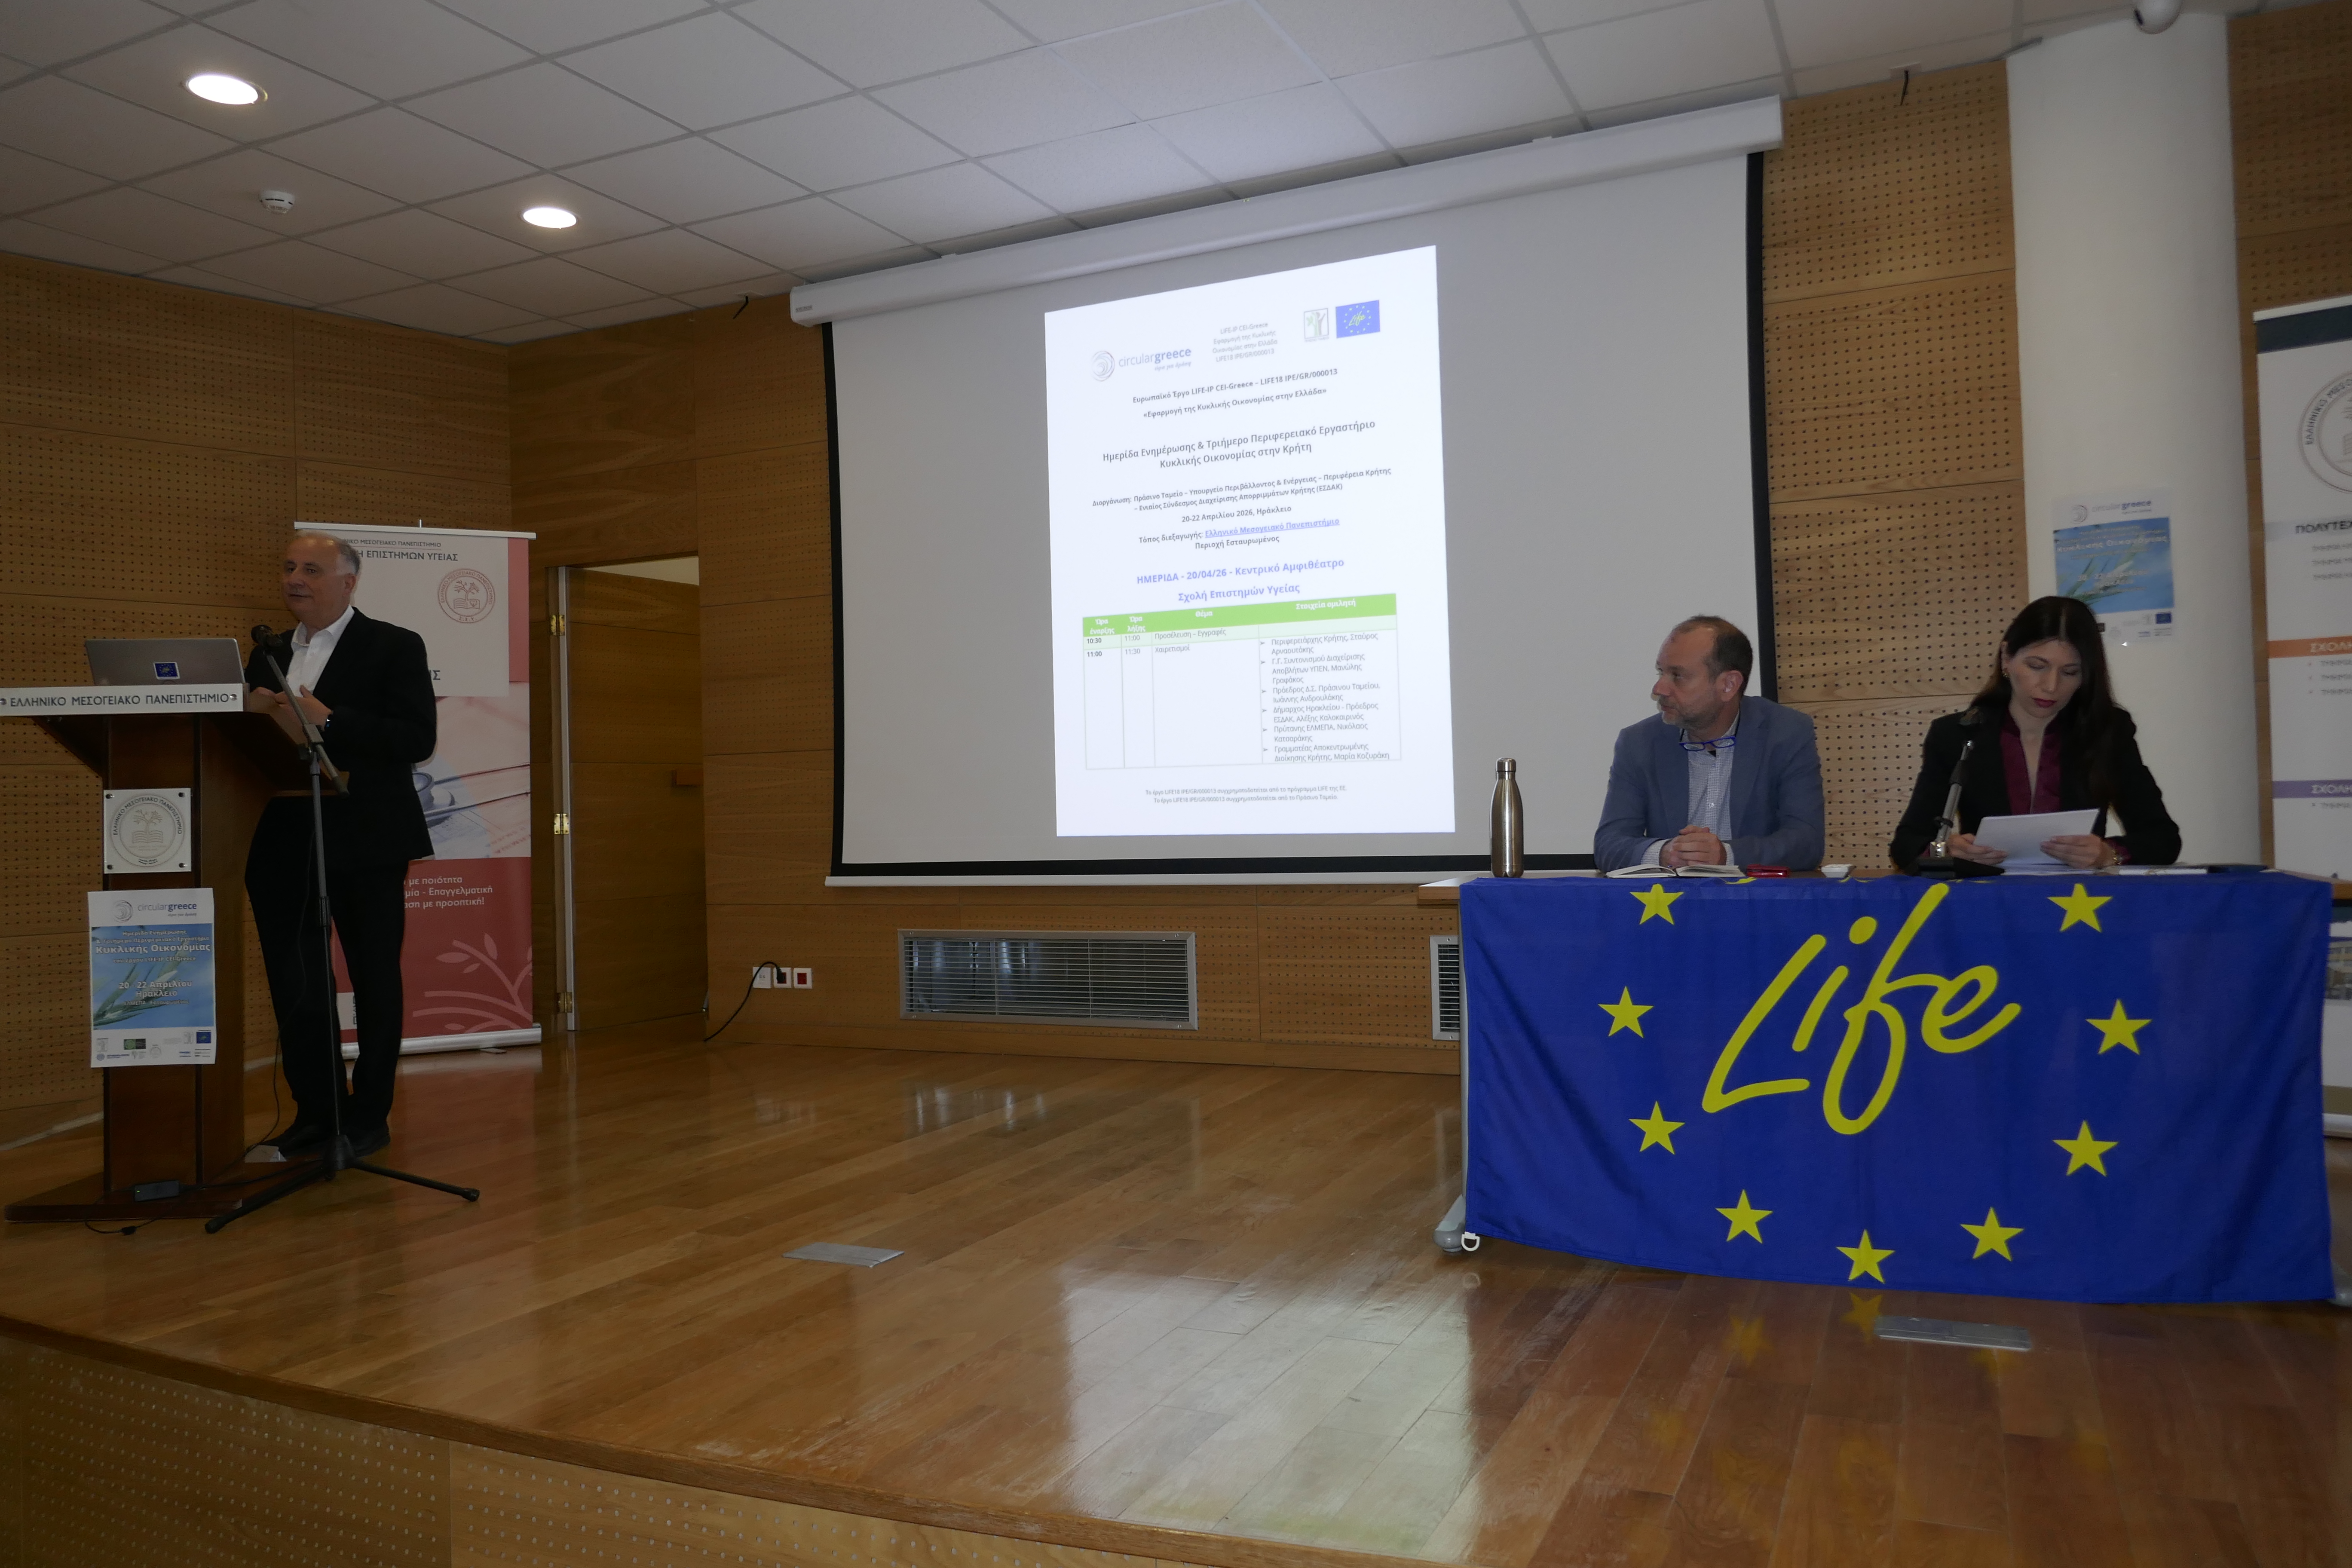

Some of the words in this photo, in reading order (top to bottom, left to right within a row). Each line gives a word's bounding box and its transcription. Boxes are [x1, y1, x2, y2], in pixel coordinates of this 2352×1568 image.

[1220, 326, 1238, 334] LIFE-IP
[1239, 322, 1268, 331] CEI-Greece
[1118, 349, 1191, 367] circulargreece
[1133, 391, 1171, 404] Ευρωπαϊκό
[1191, 386, 1213, 395] LIFE-IP
[1216, 382, 1253, 391] CEI-Greece
[1260, 376, 1283, 385] LIFE18
[1285, 368, 1337, 381] IPE/GR/000013
[1143, 406, 1182, 419] «Εφαρμογή
[1197, 400, 1230, 410] Κυκλικής
[1232, 395, 1274, 405] Οικονομίας
[1295, 388, 1326, 397] Ελλάδα»
[1103, 450, 1139, 462] Ημερίδα
[1141, 444, 1195, 457] Ενημέρωσης
[1206, 437, 1248, 450] Τριήμερο
[1251, 426, 1316, 444] Περιφερειακό
[1319, 421, 1375, 436] Εργαστήριο
[1160, 455, 1201, 468] Κυκλικής
[1203, 449, 1256, 462] Οικονομίας
[1258, 447, 1280, 457] στην
[1283, 443, 1311, 455] Κρήτη
[1092, 497, 1131, 506] Διοργάνωση:
[1134, 494, 1160, 502] Πράσινο
[1161, 490, 1183, 499] Ταμείο
[1189, 485, 1223, 495] Υπουργείο
[1225, 481, 1275, 492] Περιβάλλοντος
[1283, 476, 1317, 485] Ενέργειας
[1323, 471, 1363, 481] Περιφέρεια
[1366, 468, 1391, 476] Κρήτης
[1198, 496, 1237, 505] Διαχείρισης
[1239, 490, 1289, 500] Απορριμμάτων
[1291, 487, 1315, 495] Κρήτης
[1316, 483, 1342, 492] (ΕΣΔΑΚ)
[1201, 511, 1234, 521] Απριλίου
[1256, 506, 1291, 516] Ηράκλειο
[1161, 531, 1203, 541] διεξαγωγής:
[1205, 527, 1238, 536] Ελληνικό
[1240, 523, 1284, 533] Μεσογειακό
[1286, 518, 1339, 528] Πανεπιστήμιο
[1195, 539, 1224, 550] Περιοχή
[1226, 536, 1279, 545] Εσταυρωμένος
[367, 551, 424, 560] ΕΠΙΣΤΗΜΩΝ
[1137, 573, 1179, 584] ΗΜΕΡΙΔΑ
[1186, 569, 1226, 579] 20/04/26
[1235, 563, 1280, 576] Κεντρικό
[1282, 559, 1344, 573] Αμφιθέατρο
[1178, 590, 1207, 603] Σχολή
[1210, 586, 1264, 598] Επιστημών
[1267, 583, 1300, 596] Υγείας
[1296, 600, 1326, 610] Στοιχεία
[1326, 598, 1356, 609] ομιλητή
[1155, 631, 1191, 640] Προσέλευση
[1197, 628, 1226, 637] Εγγραφές
[1271, 636, 1322, 646] Περιφερειάρχης
[1350, 632, 1378, 640] Σταύρος
[1155, 644, 1190, 653] Χαιρετισμοί
[1271, 646, 1314, 655] Αρναουτάκης
[1272, 666, 1308, 675] Αποβλήτων
[1272, 676, 1304, 685] Γραφάκος
[1273, 686, 1304, 695] Πρόεδρος
[1318, 683, 1350, 692] Πράσινου
[10, 697, 67, 707] ΕΛΛΗΝΙΚΟ
[72, 695, 141, 706] ΜΕΣΟΓΕΙΑΚΟ
[145, 693, 230, 704] ΠΑΝΕΠΙΣΤΗΜΙΟ
[1300, 693, 1343, 702] Ανδρουλάκης
[1273, 705, 1305, 714] Δήμαρχος
[1306, 703, 1340, 713] Ηρακλείου
[1346, 702, 1378, 711] Πρόεδρος
[1296, 714, 1318, 723] Αλέξης
[1320, 712, 1364, 721] Καλοκαιρινός
[1274, 725, 1305, 733] Πρύτανης
[1274, 734, 1312, 743] Κατσαράκης
[1274, 744, 1312, 753] Γραμματέας
[1313, 742, 1369, 751] Αποκεντρωμένης
[1334, 752, 1355, 761] Μαρία
[1357, 751, 1389, 760] Κοζυράκη
[113, 808, 125, 835] ΕΛΛΗΝΙΚΟ
[125, 797, 159, 809] ΜΕΣΟΓΕΙΑΚΟ
[159, 799, 182, 834] ΠΑΝΕΠΙΣΤΗΜΙΟ
[409, 879, 420, 887] με
[422, 876, 462, 885] ποιότητα
[429, 885, 493, 897] Επαγγελματική
[138, 903, 197, 912] circulargreece
[423, 901, 433, 910] με
[436, 897, 485, 909] προοπτική!
[96, 945, 148, 954] Κυκλικής
[151, 943, 210, 952] Οικονομίας
[149, 980, 192, 989] Απριλίου
[1701, 882, 2021, 1136] Life
